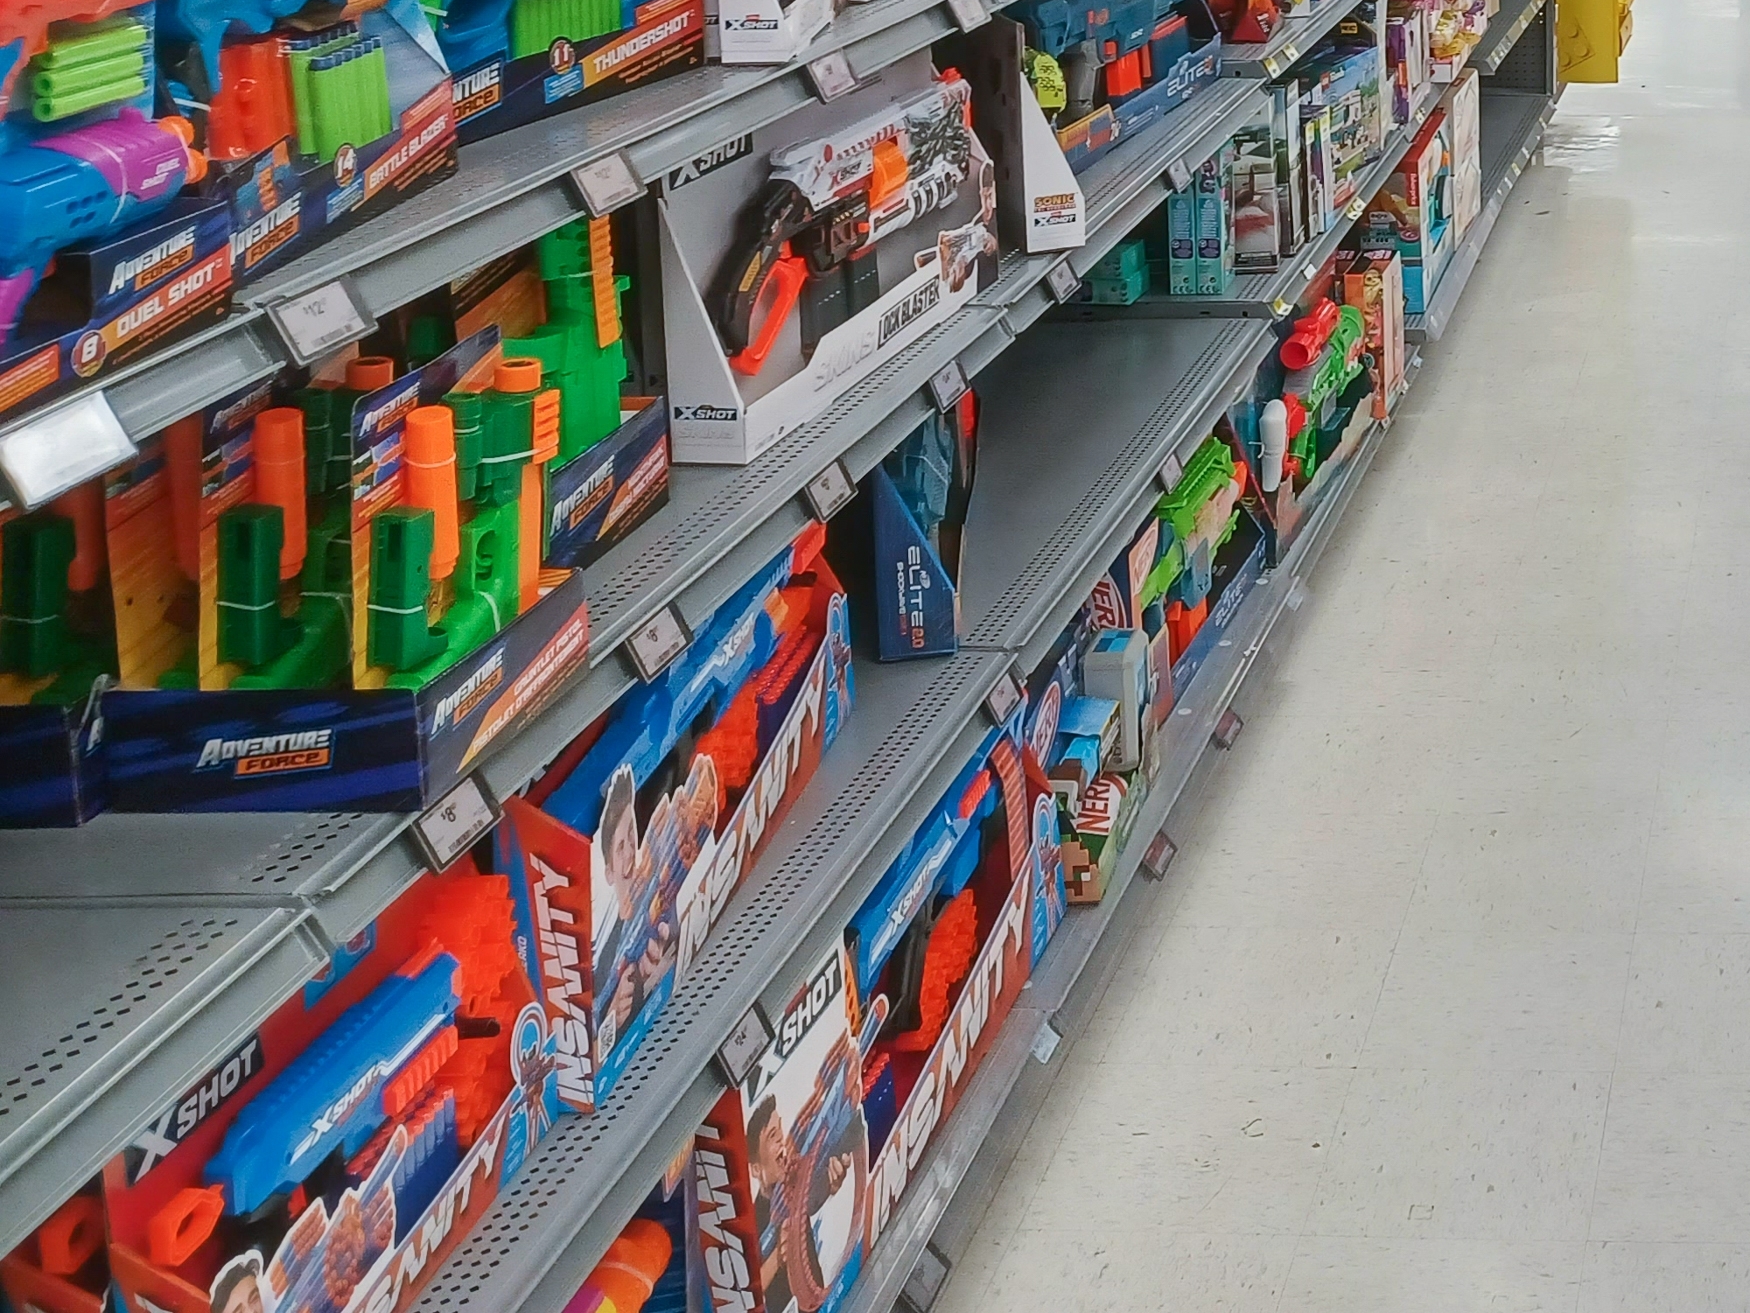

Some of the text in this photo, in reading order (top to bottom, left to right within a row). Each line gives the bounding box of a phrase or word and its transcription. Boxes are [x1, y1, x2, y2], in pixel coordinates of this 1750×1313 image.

[593, 12, 690, 74] THUNDERSHOT
[108, 225, 197, 295] ADVENTURE
[140, 248, 189, 285] FORCE
[115, 266, 217, 338] DUEL SHOT
[902, 279, 940, 326] BLASTER
[551, 456, 614, 534] ADVENTURE
[907, 544, 925, 627] ELITE
[431, 648, 504, 734] ADVENTURE
[196, 729, 333, 769] ADVENTURE
[240, 750, 327, 773] FORCE
[530, 852, 593, 1106] INSANITY
[870, 870, 1031, 1248] INSANITY
